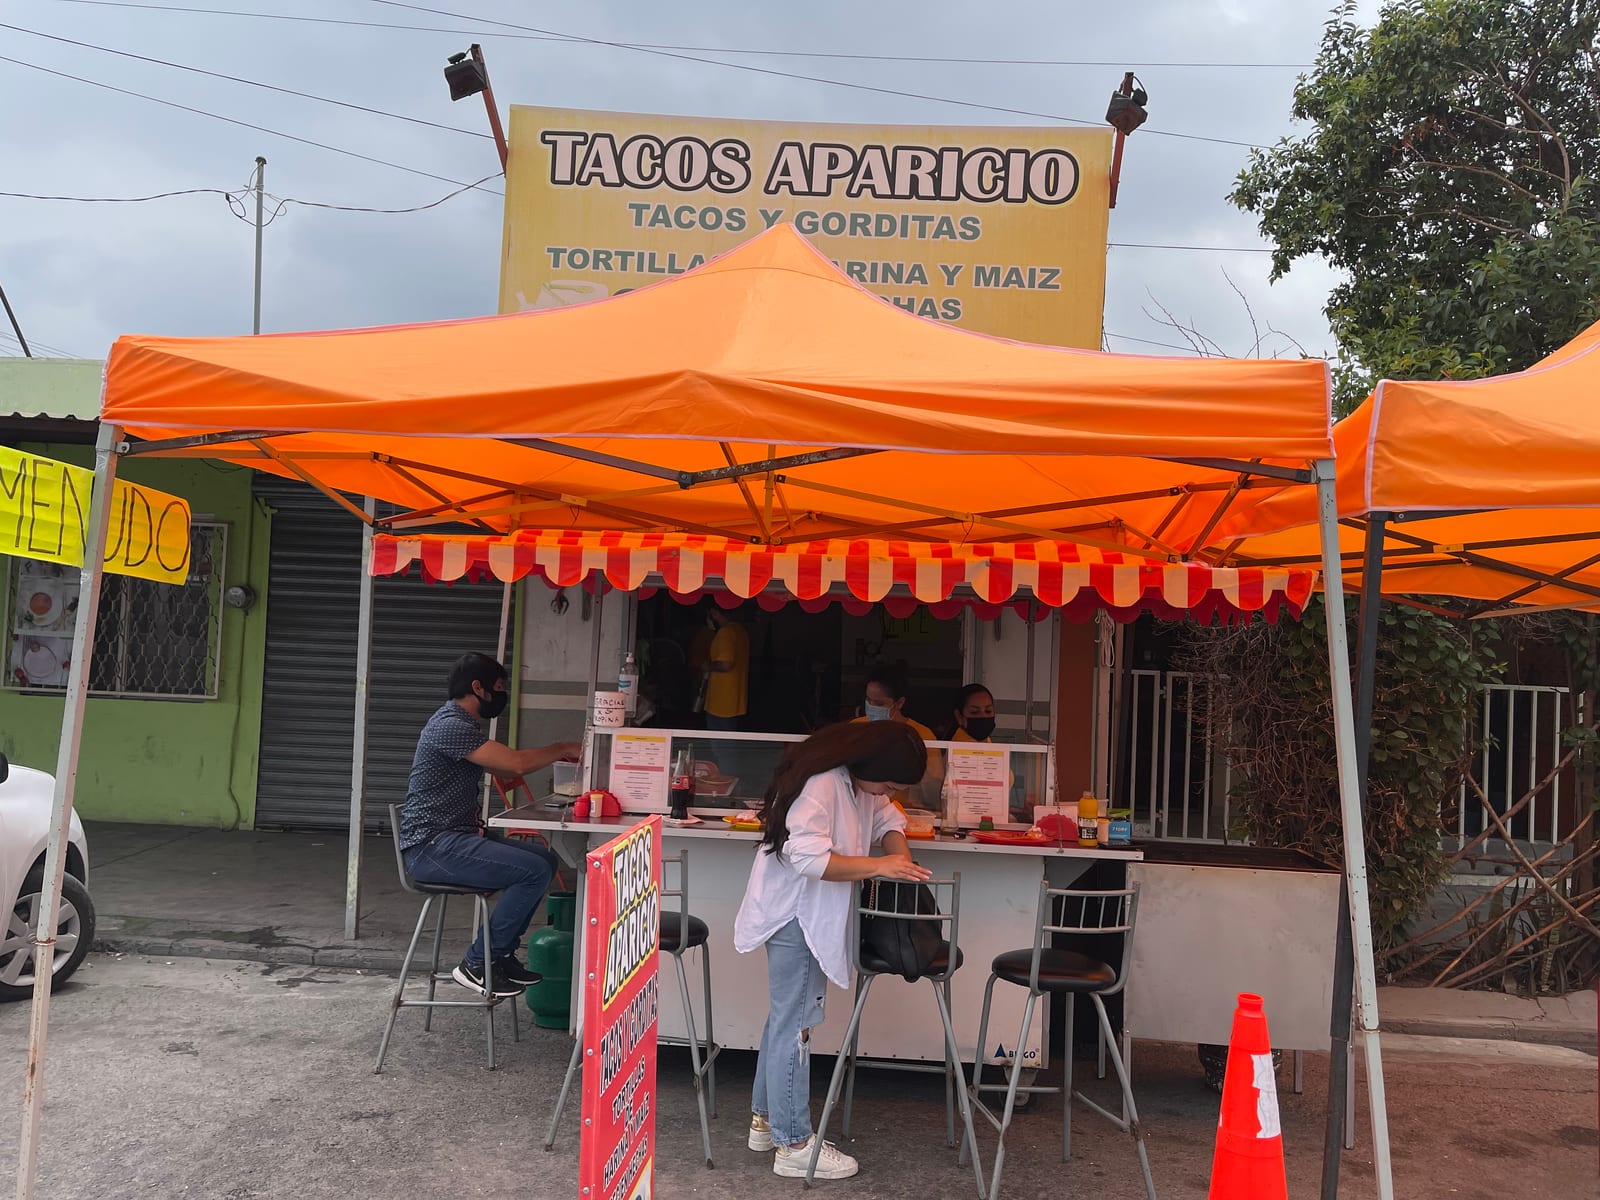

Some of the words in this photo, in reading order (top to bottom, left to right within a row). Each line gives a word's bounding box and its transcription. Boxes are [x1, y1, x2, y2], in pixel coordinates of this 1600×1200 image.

[541, 131, 751, 193] TACOS
[764, 141, 1079, 205] APARICIO
[628, 203, 746, 231] TACOS
[759, 209, 783, 229] Y
[795, 211, 981, 240] GORDITAS
[547, 247, 718, 274] TORTILLA
[831, 261, 928, 285] RINA
[940, 264, 963, 286] Y
[974, 265, 1060, 289] MAIZ
[879, 296, 961, 320] HAS
[614, 827, 651, 916] TACOS
[603, 888, 658, 1006] APARICIO
[600, 1014, 624, 1096] TACOS
[1009, 1050, 1036, 1059] BGO
[612, 1055, 645, 1125] TORTILLAS
[603, 1128, 629, 1192] HARINA
